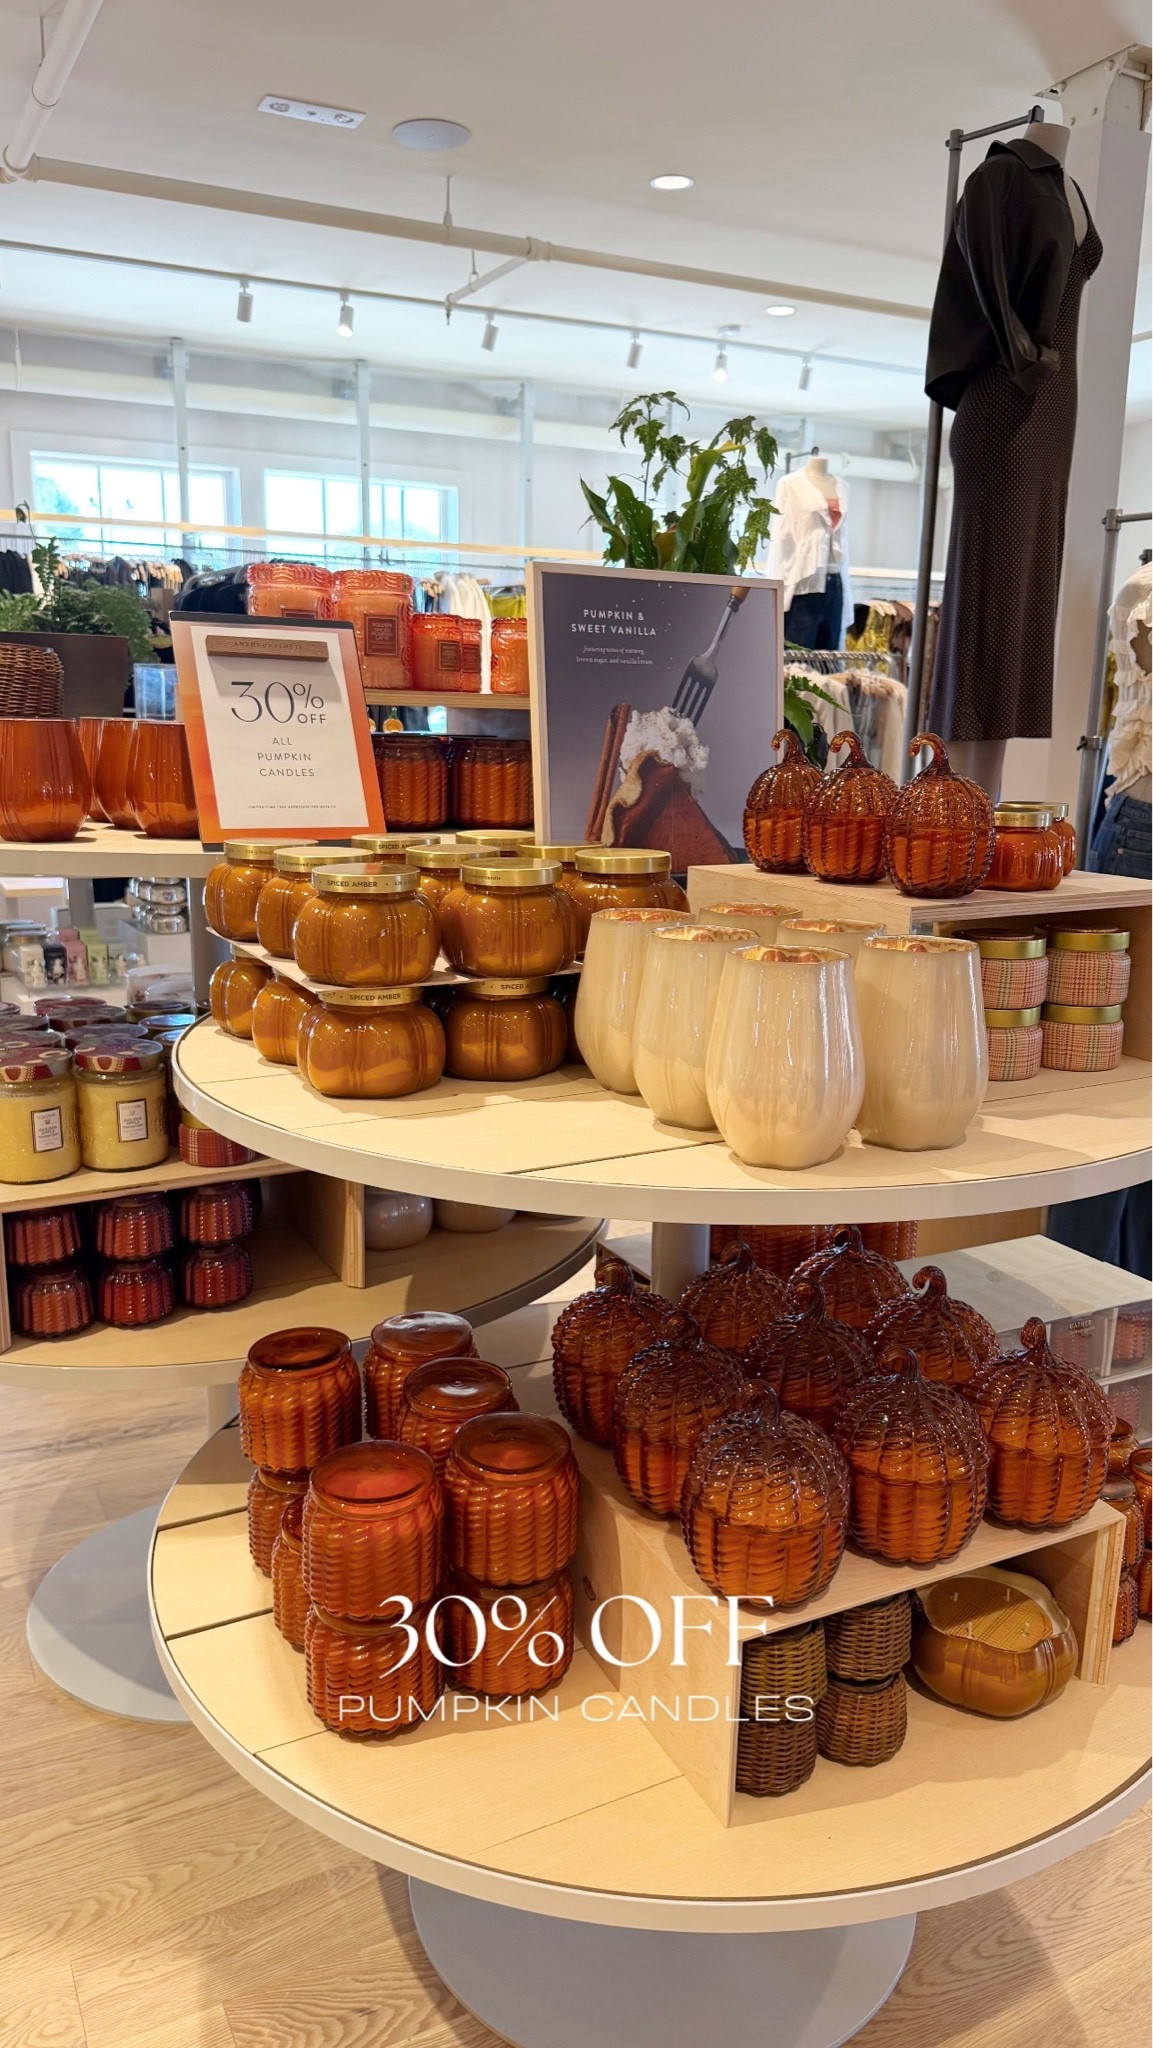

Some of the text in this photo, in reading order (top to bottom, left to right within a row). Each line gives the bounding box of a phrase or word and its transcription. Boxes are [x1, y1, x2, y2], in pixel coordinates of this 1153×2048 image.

[583, 609, 645, 621] PUMPKIN &
[571, 623, 657, 636] SWEET VANILLA
[231, 681, 327, 724] 30% OFF
[272, 737, 293, 746] ALL
[257, 752, 312, 762] PUMPKIN
[259, 768, 315, 777] CANDLES
